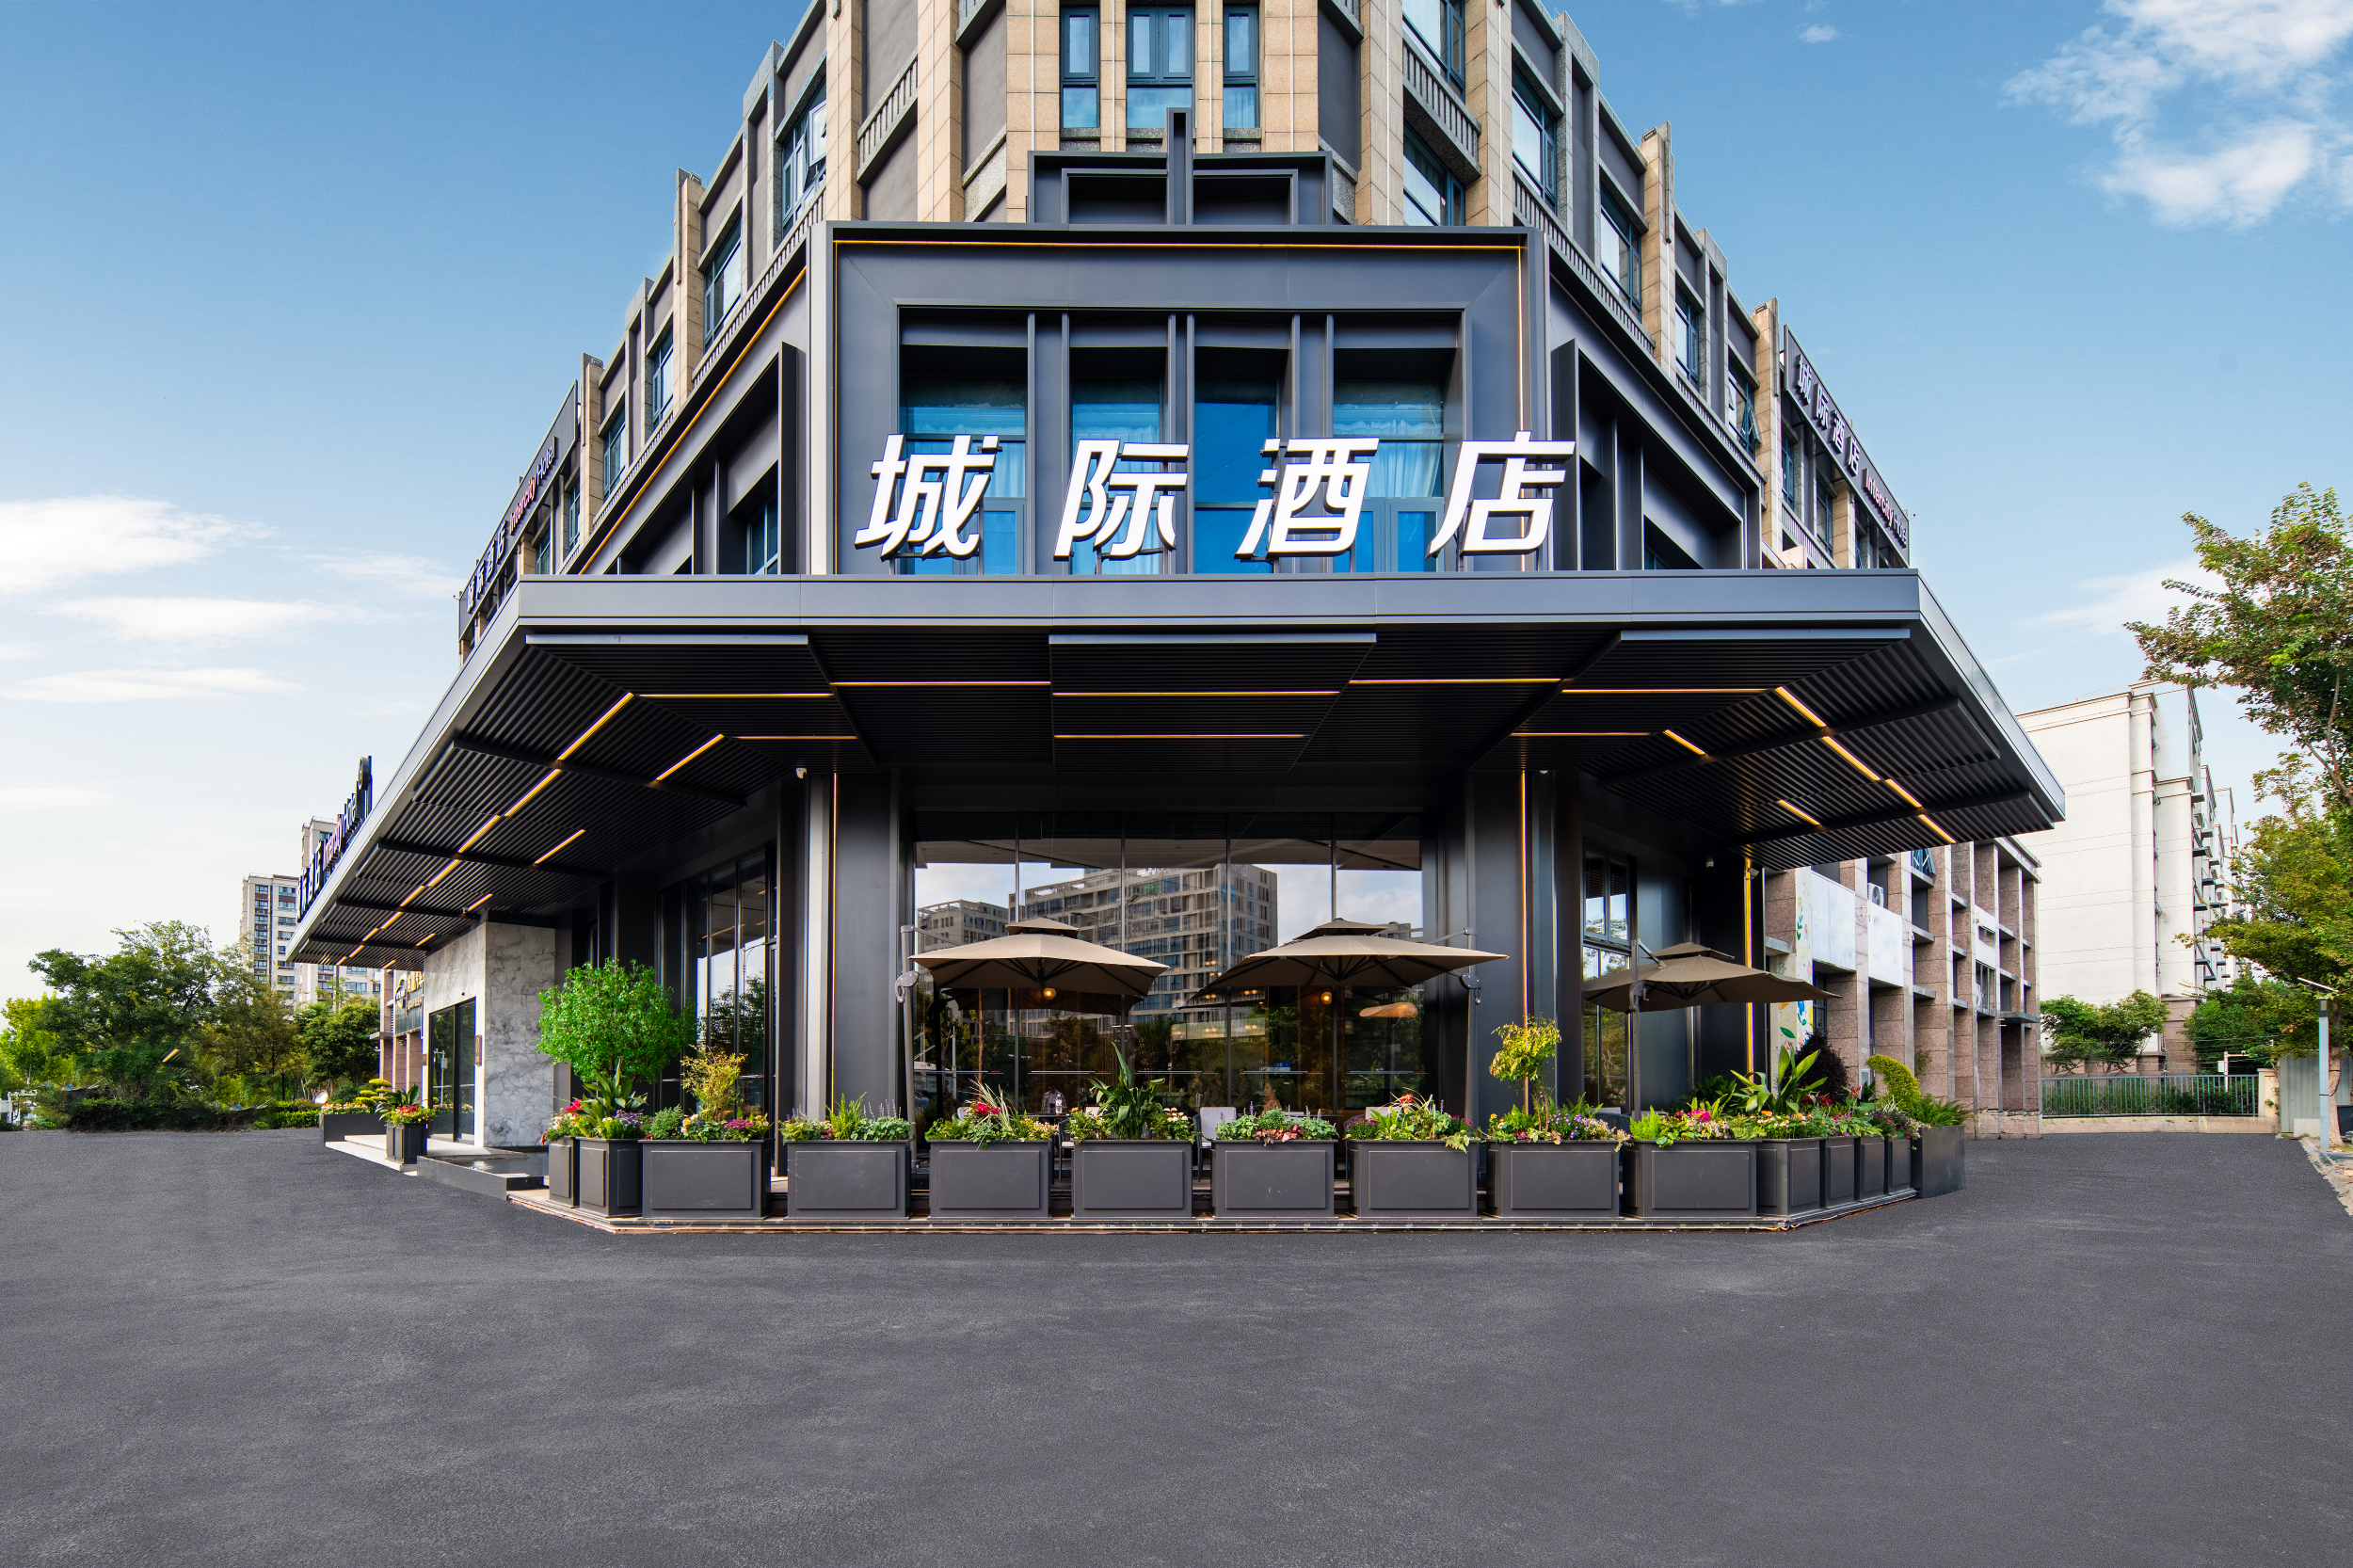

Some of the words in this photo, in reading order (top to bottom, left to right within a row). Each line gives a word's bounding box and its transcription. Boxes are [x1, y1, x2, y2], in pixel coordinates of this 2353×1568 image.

[1796, 353, 1861, 476] 城际酒店
[854, 429, 1577, 561] 城际酒店
